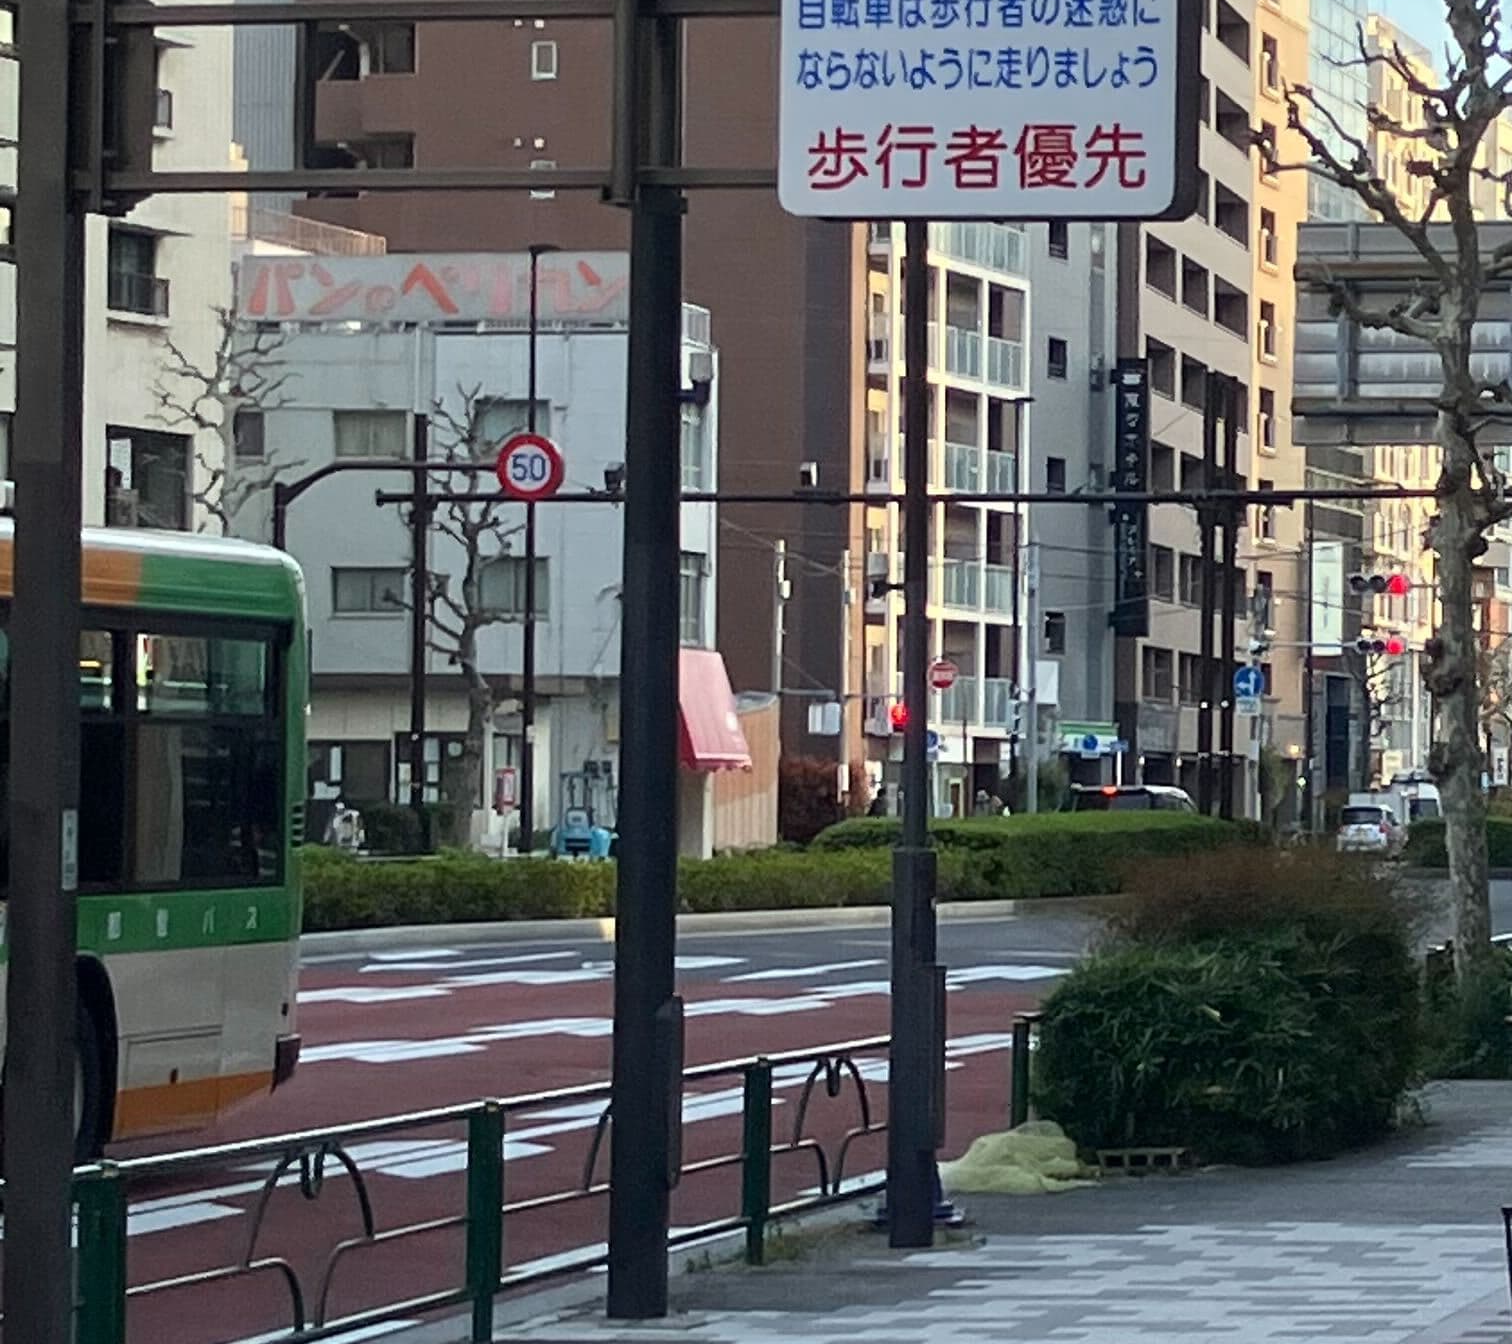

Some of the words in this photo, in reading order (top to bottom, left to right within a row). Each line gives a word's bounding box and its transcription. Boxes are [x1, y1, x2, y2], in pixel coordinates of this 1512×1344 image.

[796, 45, 1159, 90] ならないように走りましょう
[808, 123, 1147, 191] 歩行者優先
[512, 454, 546, 481] 50
